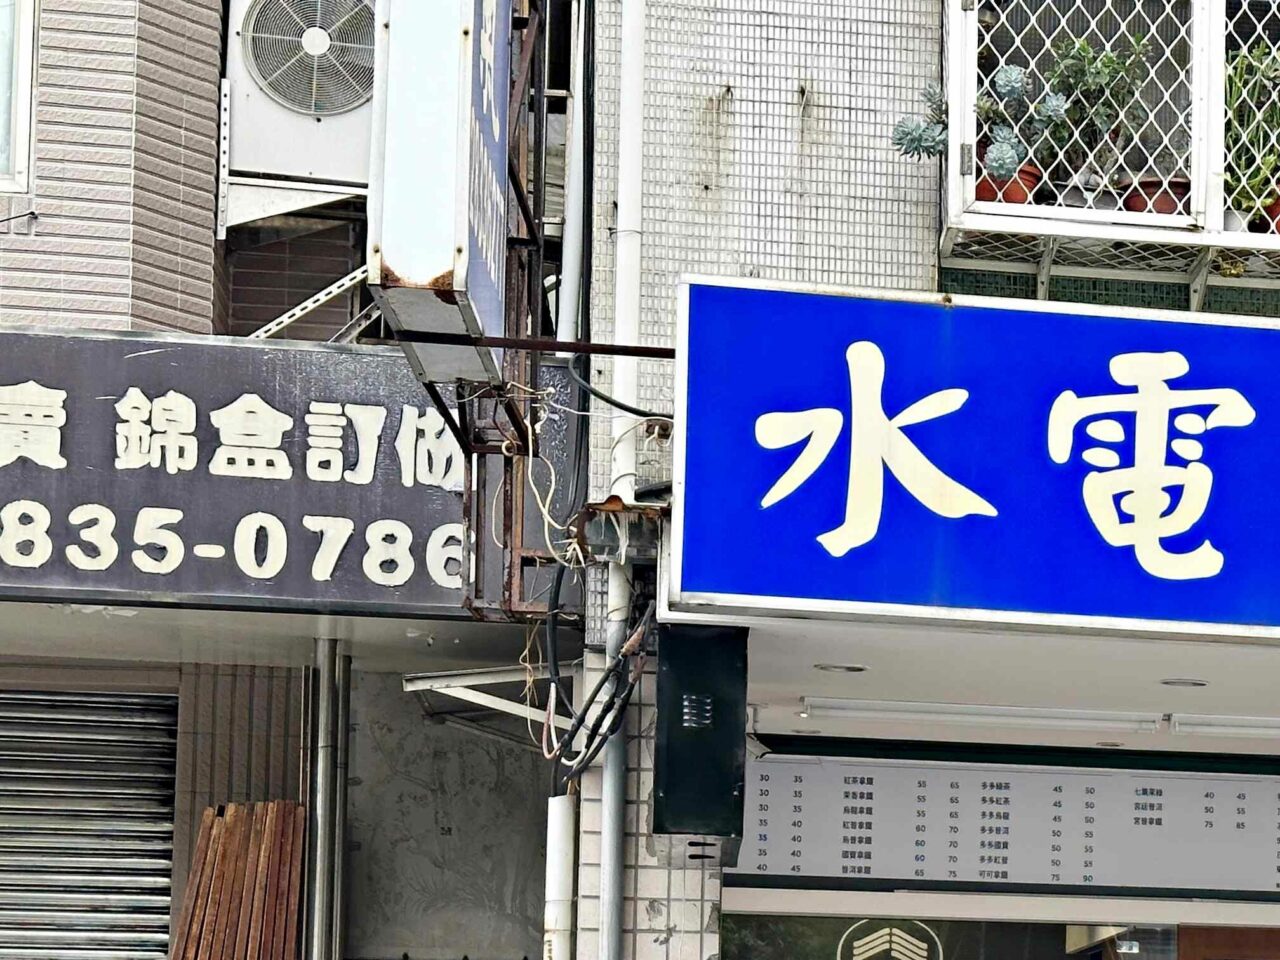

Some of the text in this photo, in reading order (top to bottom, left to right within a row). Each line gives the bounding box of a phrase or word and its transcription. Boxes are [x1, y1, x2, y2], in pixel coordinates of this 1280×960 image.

[759, 773, 804, 784] 30 35
[949, 781, 960, 790] 65
[1052, 785, 1063, 794] 45
[1085, 786, 1096, 795] 50
[758, 788, 803, 799] 30 35
[1203, 791, 1216, 800] 40
[1236, 792, 1247, 801] 45
[949, 796, 960, 805] 65
[1051, 799, 1063, 809] 45
[1084, 801, 1096, 810] 50
[757, 803, 803, 814] 30 35
[1203, 805, 1215, 814] 50
[1236, 807, 1246, 816] 55
[948, 810, 960, 819] 65
[758, 818, 803, 829] 35 40
[1051, 815, 1063, 823] 45
[1084, 815, 1095, 825] 50
[1204, 820, 1214, 829] 75
[1235, 821, 1246, 830] 85
[948, 825, 960, 834] 70
[1051, 829, 1063, 838] 50
[1083, 830, 1094, 839] 55
[757, 833, 803, 843] 35 40
[948, 840, 959, 849] 70
[1051, 844, 1062, 853] 50
[1083, 844, 1094, 854] 55
[757, 848, 802, 858] 35 40
[947, 855, 959, 864] 70
[1050, 858, 1062, 868] 50
[1083, 859, 1094, 868] 55
[756, 863, 801, 872] 40 45
[947, 870, 958, 879] 75
[1050, 873, 1061, 882] 75
[1082, 874, 1094, 883] 90
